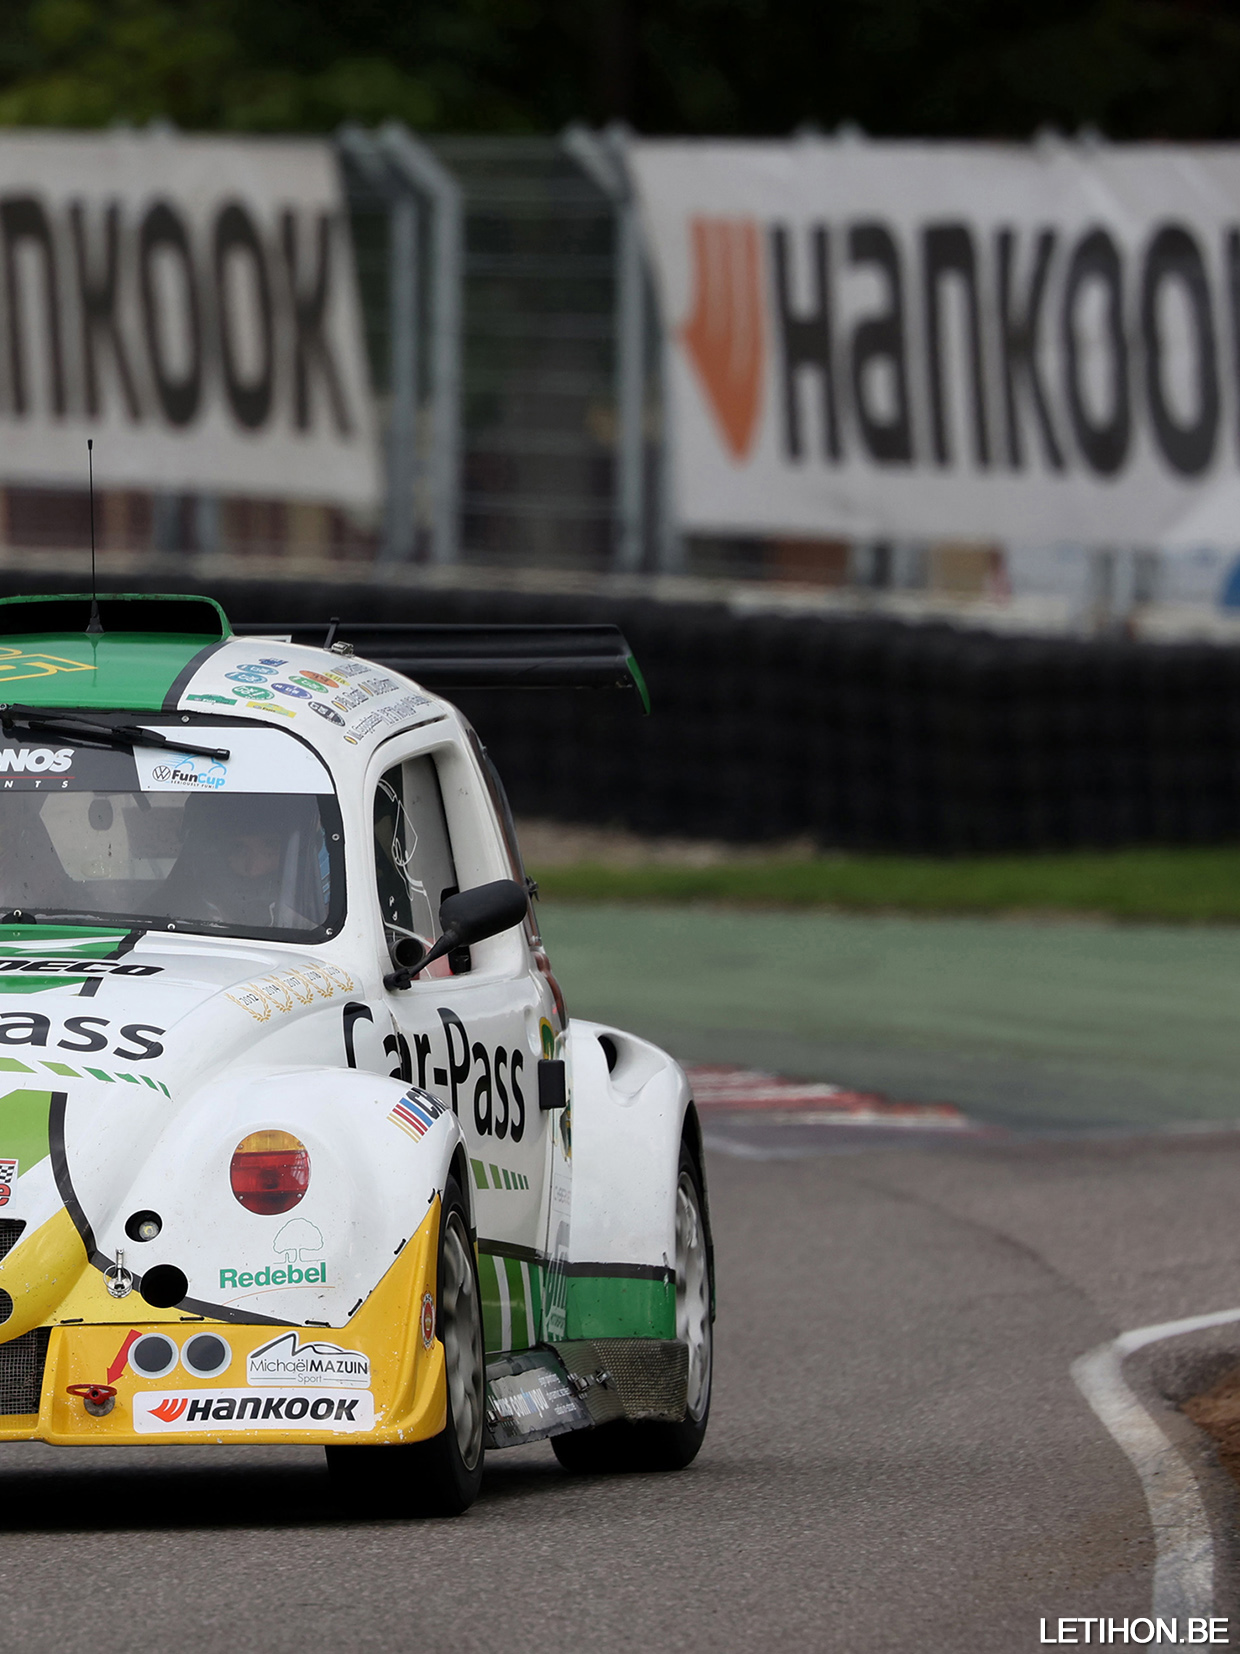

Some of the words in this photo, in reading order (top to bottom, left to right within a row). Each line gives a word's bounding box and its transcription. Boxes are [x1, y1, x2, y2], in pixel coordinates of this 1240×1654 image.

[172, 770, 226, 789] FunCup
[343, 1001, 526, 1143] Car-Pass
[219, 1262, 327, 1289] Redebel
[297, 1373, 322, 1385] Sport
